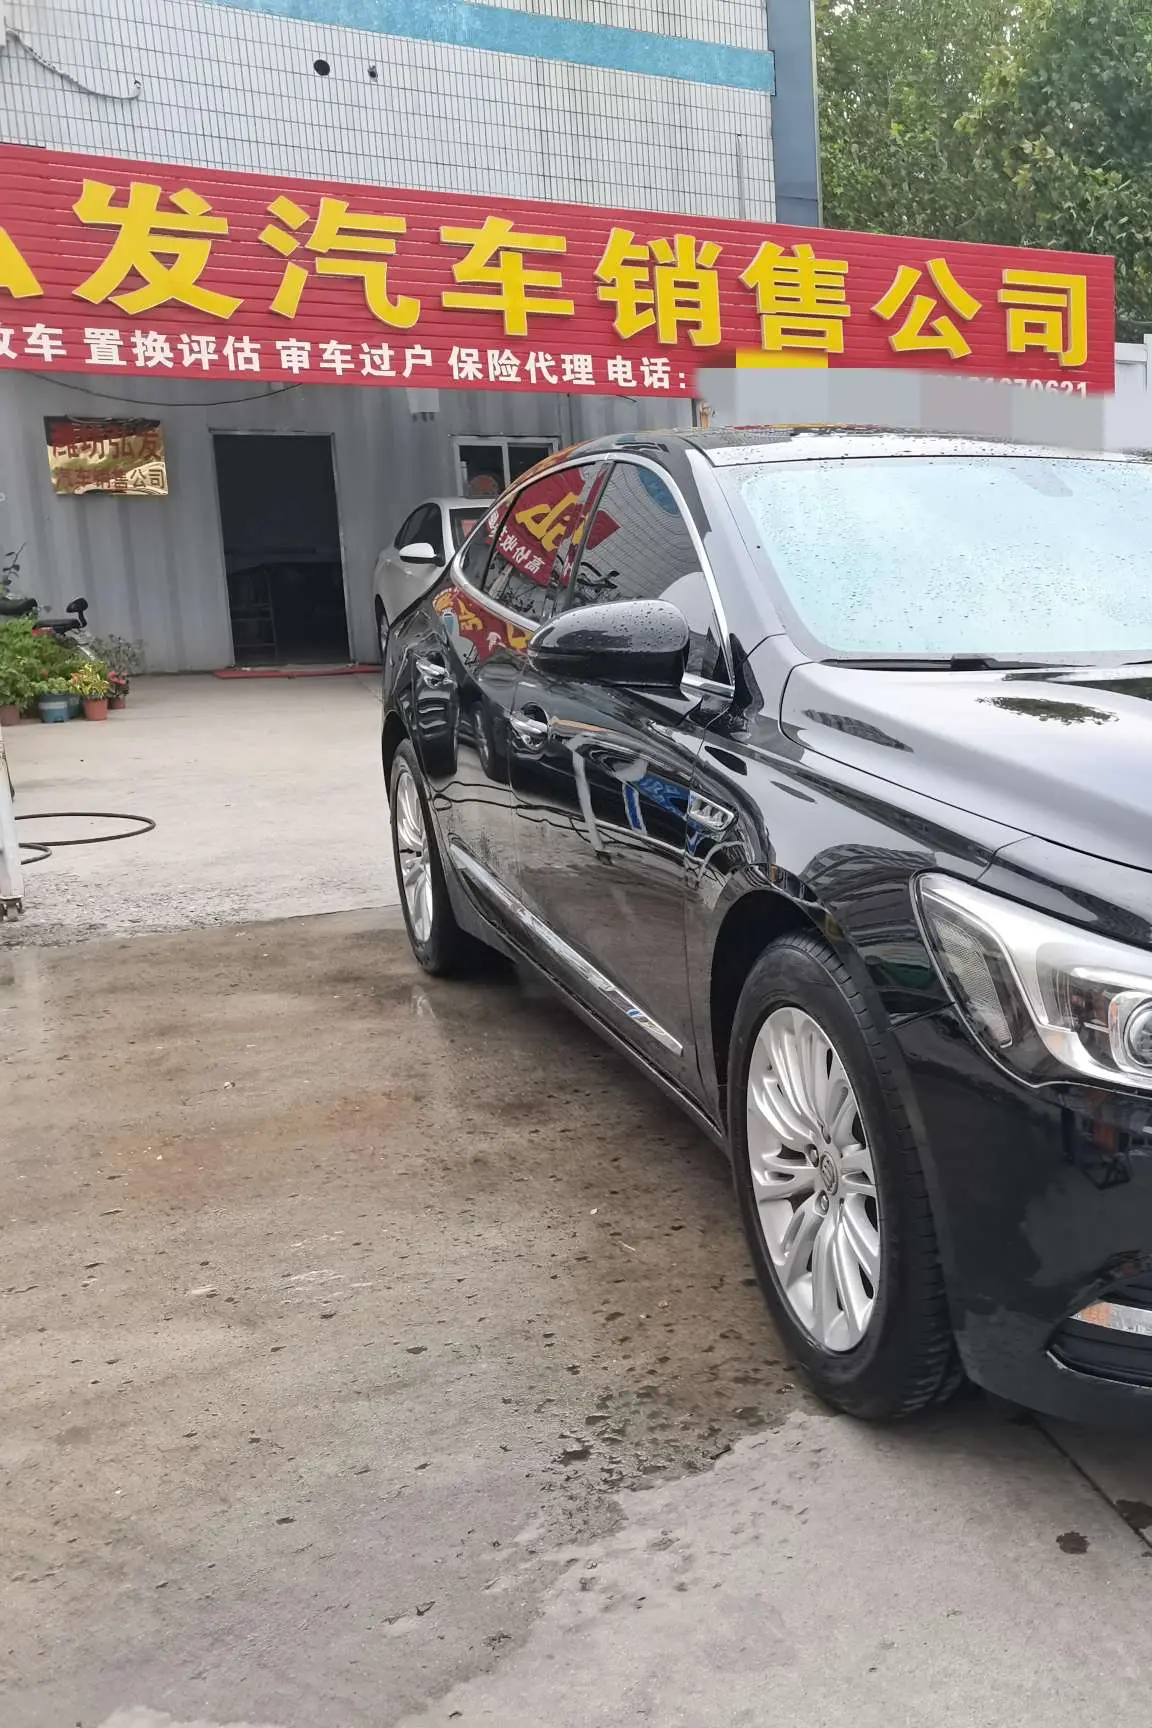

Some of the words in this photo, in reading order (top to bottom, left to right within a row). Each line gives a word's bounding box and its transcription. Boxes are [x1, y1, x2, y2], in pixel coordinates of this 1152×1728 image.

[83, 327, 261, 372] 置换评估
[275, 337, 433, 378] 审车过户
[448, 345, 596, 387] 保险代理
